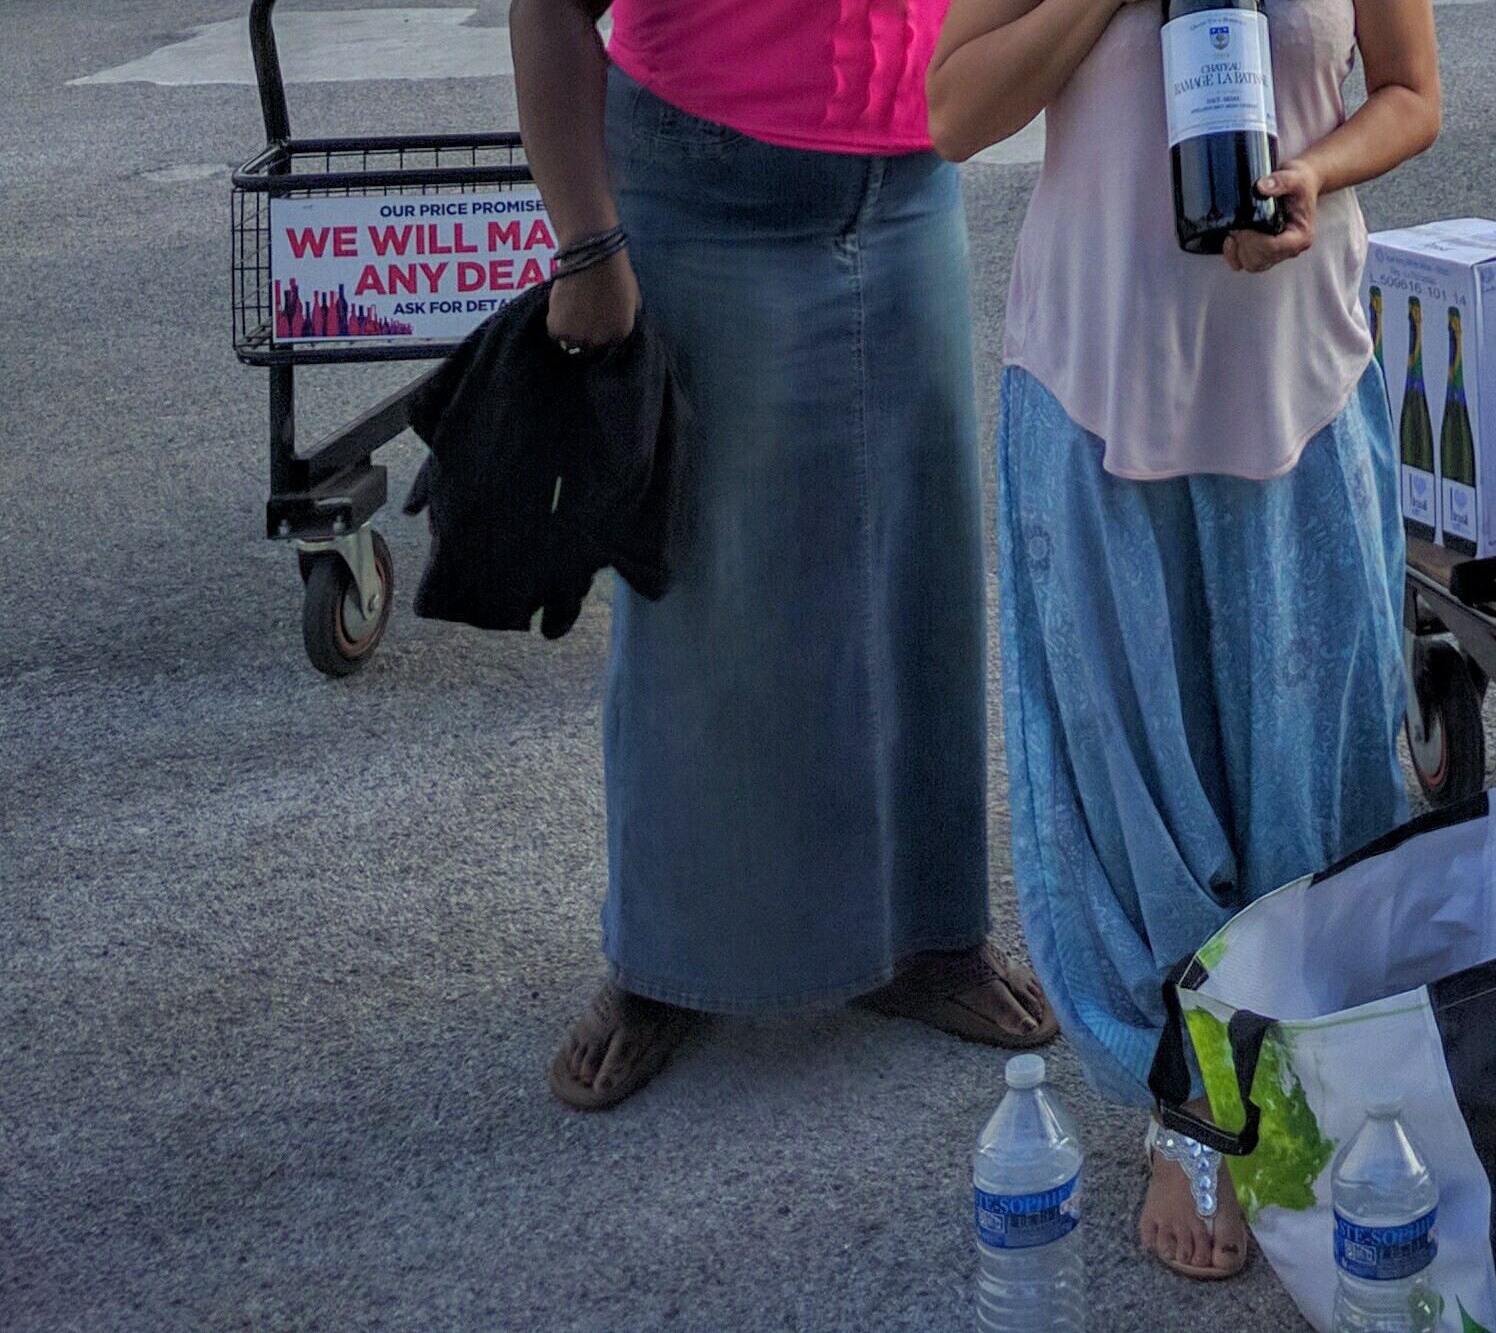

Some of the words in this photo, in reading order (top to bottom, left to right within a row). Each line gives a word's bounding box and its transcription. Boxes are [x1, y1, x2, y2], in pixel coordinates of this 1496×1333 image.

[380, 205, 415, 217] OUR
[419, 203, 467, 216] PRICE
[472, 200, 546, 214] PROMISE
[285, 226, 358, 258] WE
[368, 223, 478, 256] WILL
[487, 219, 557, 252] MA
[354, 262, 450, 296] ANY
[394, 302, 426, 315] ASK
[430, 301, 462, 314] FOR
